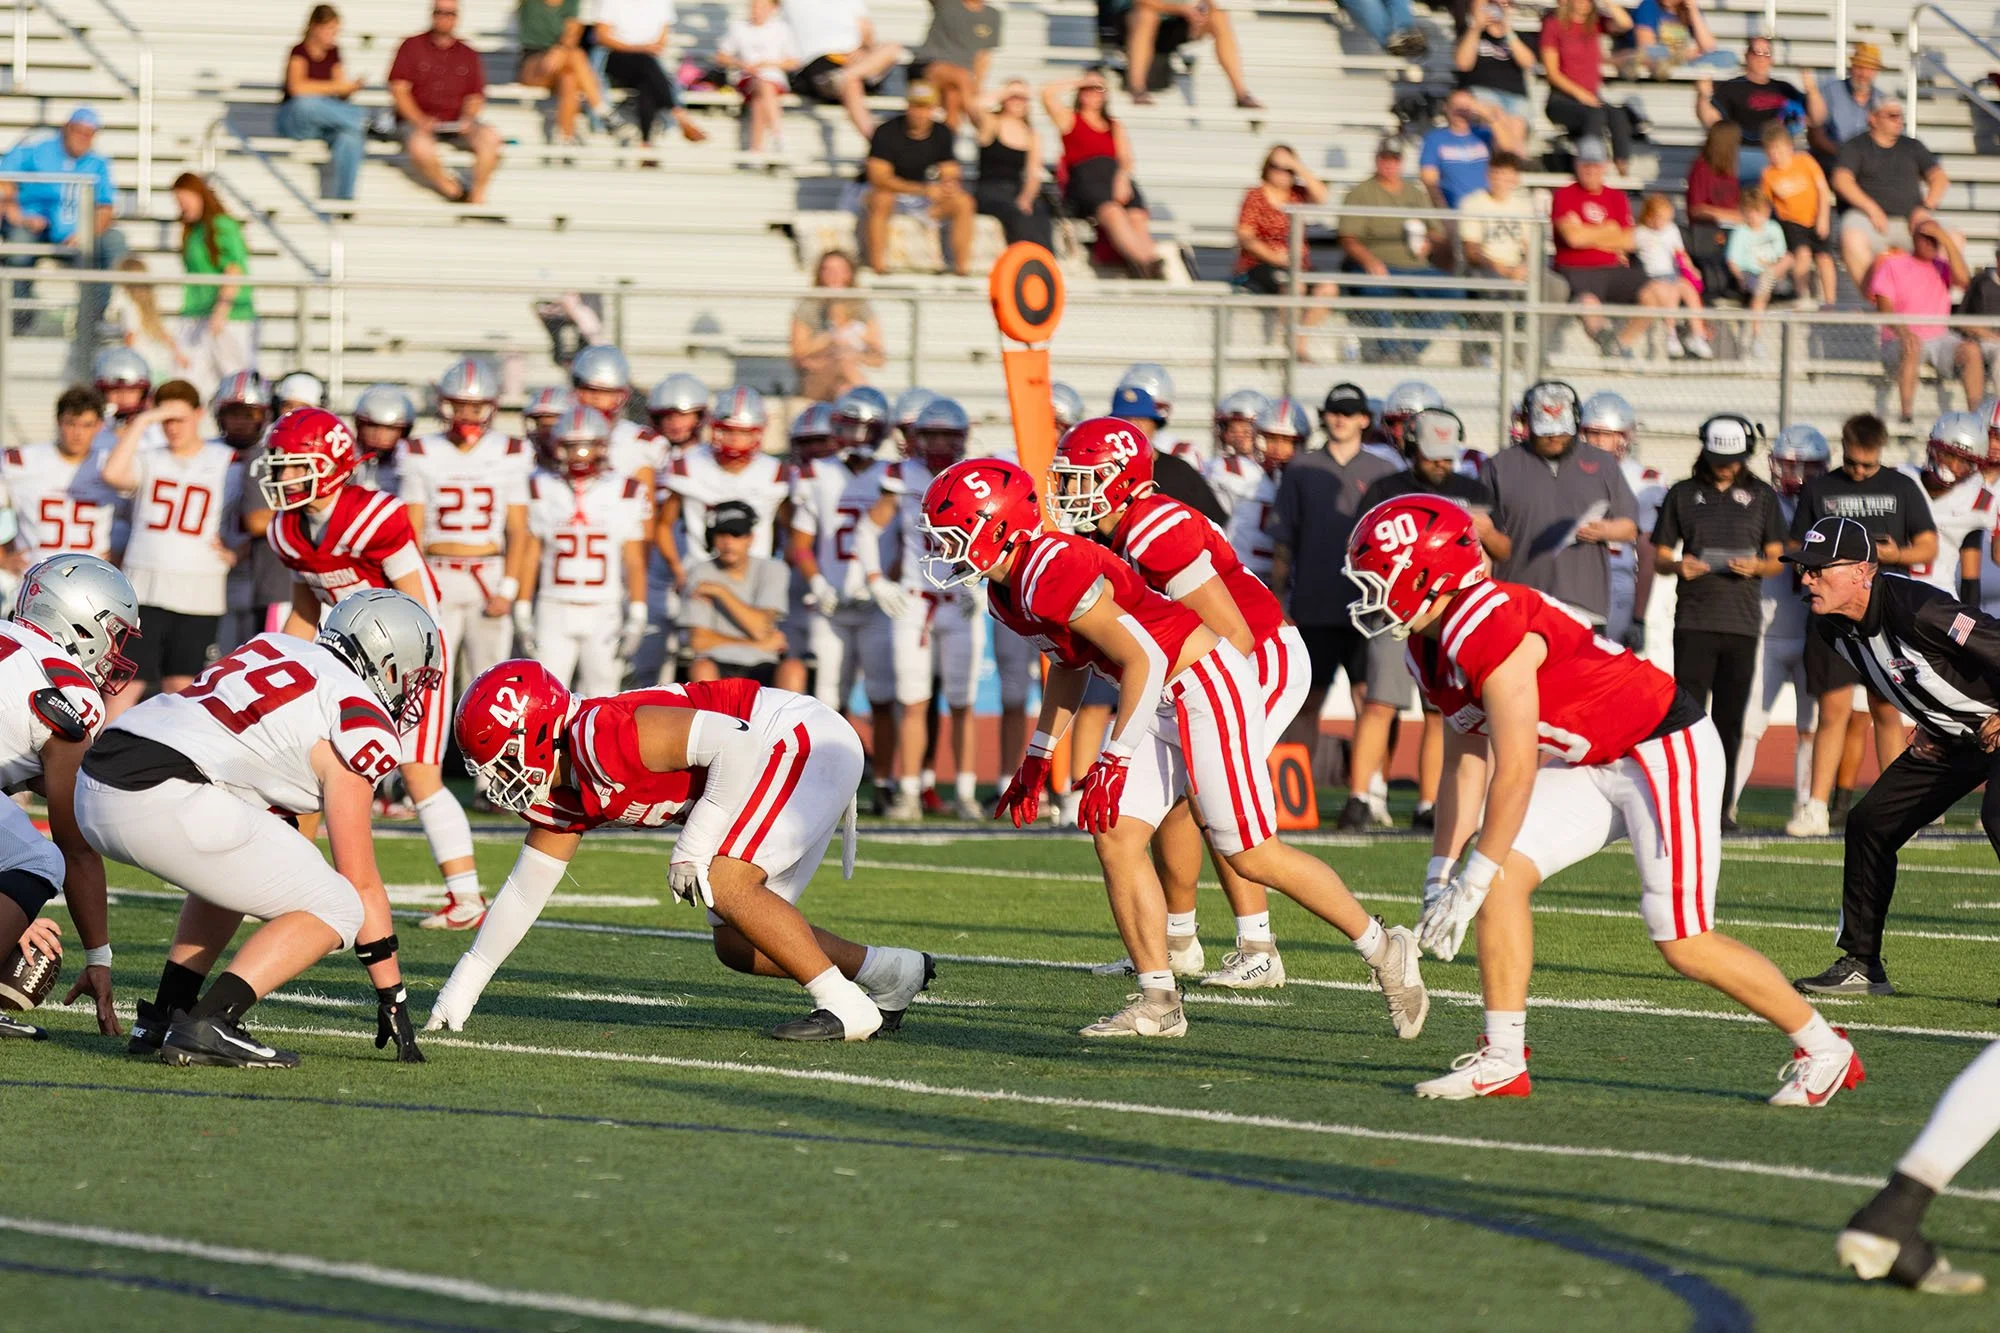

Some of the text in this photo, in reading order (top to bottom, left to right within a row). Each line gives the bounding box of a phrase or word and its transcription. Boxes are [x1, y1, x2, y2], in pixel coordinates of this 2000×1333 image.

[325, 423, 353, 458] 25
[1104, 430, 1139, 461] 33
[963, 471, 992, 499] 5
[39, 498, 97, 549] 55
[147, 479, 211, 536] 50
[437, 486, 494, 531] 23
[1374, 512, 1419, 553] 90
[554, 534, 608, 586] 25
[488, 686, 530, 729] 42
[349, 739, 399, 784] 69
